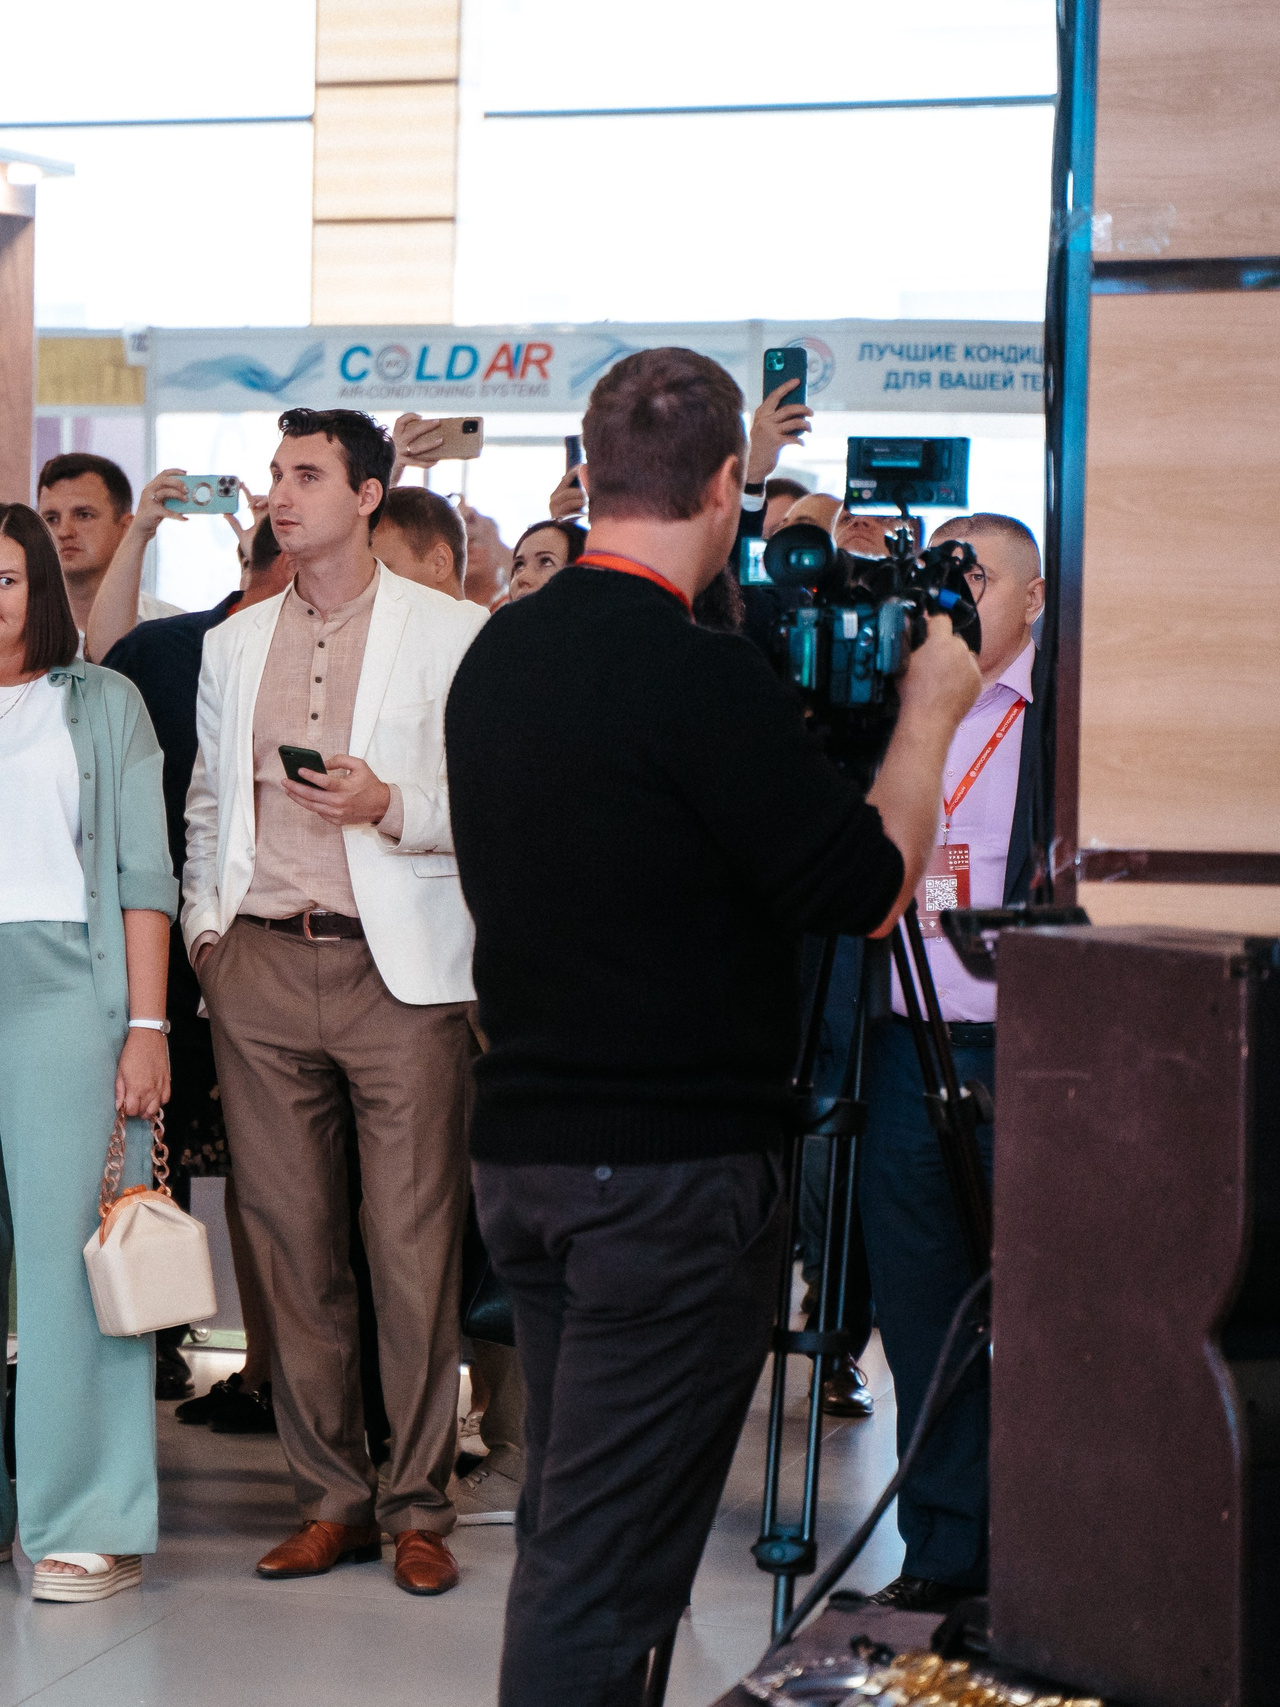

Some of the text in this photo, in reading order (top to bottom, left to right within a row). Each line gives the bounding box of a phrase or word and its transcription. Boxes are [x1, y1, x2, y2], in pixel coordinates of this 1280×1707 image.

[857, 342, 957, 362] ЛУЧШИЕ
[481, 383, 551, 398] SYSTEMS
[883, 371, 931, 392] ДЛЯ
[939, 369, 1014, 391] ВАШЕЙ
